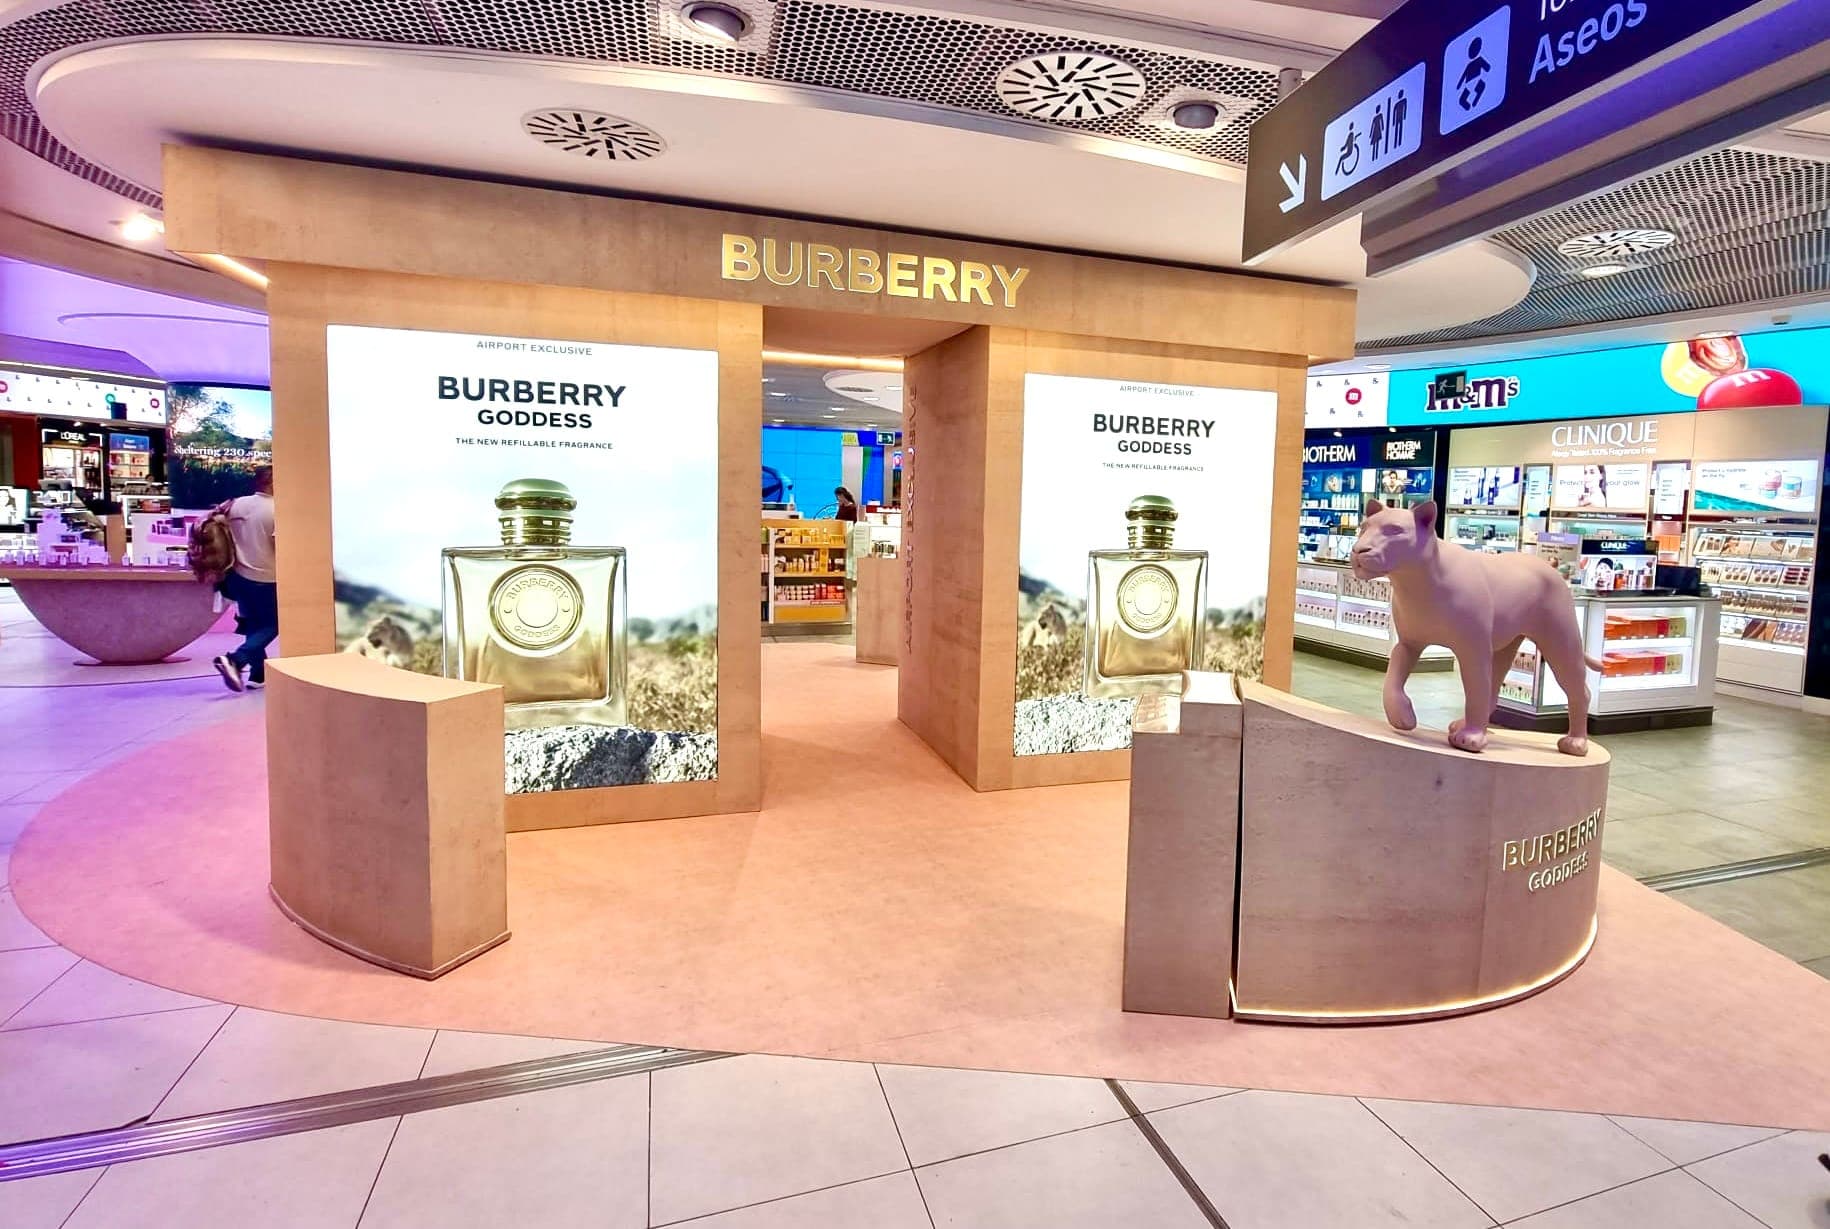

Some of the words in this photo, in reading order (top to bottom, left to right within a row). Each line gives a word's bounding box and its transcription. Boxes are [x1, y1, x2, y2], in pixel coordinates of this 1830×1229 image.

[1528, 0, 1647, 84] Aseos
[721, 233, 1030, 308] BURBERRY
[476, 340, 527, 352] AIRPORT
[530, 344, 593, 356] EXCLUSIVE
[438, 375, 626, 408] BURBERRY
[1119, 385, 1152, 393] AIRPORT
[1154, 386, 1195, 397] EXCLUSIVE
[477, 409, 593, 429] GODDESS
[1093, 413, 1216, 439] BURBERRY
[1552, 420, 1659, 448] CLINIQUE
[174, 444, 221, 457] Sheltering
[223, 447, 245, 456] 230
[455, 437, 475, 445] THE
[476, 438, 498, 446] NEW
[501, 439, 557, 448] REFILLABLE
[559, 441, 613, 450] FRAGRANCE
[1117, 439, 1192, 456] GODDESS
[1387, 440, 1421, 451] BIOTHERM
[1386, 449, 1416, 460] HOMME
[1600, 541, 1628, 550] CLINIQUE
[1502, 807, 1602, 872] BURBERRY
[1528, 851, 1589, 892] GODDESS
